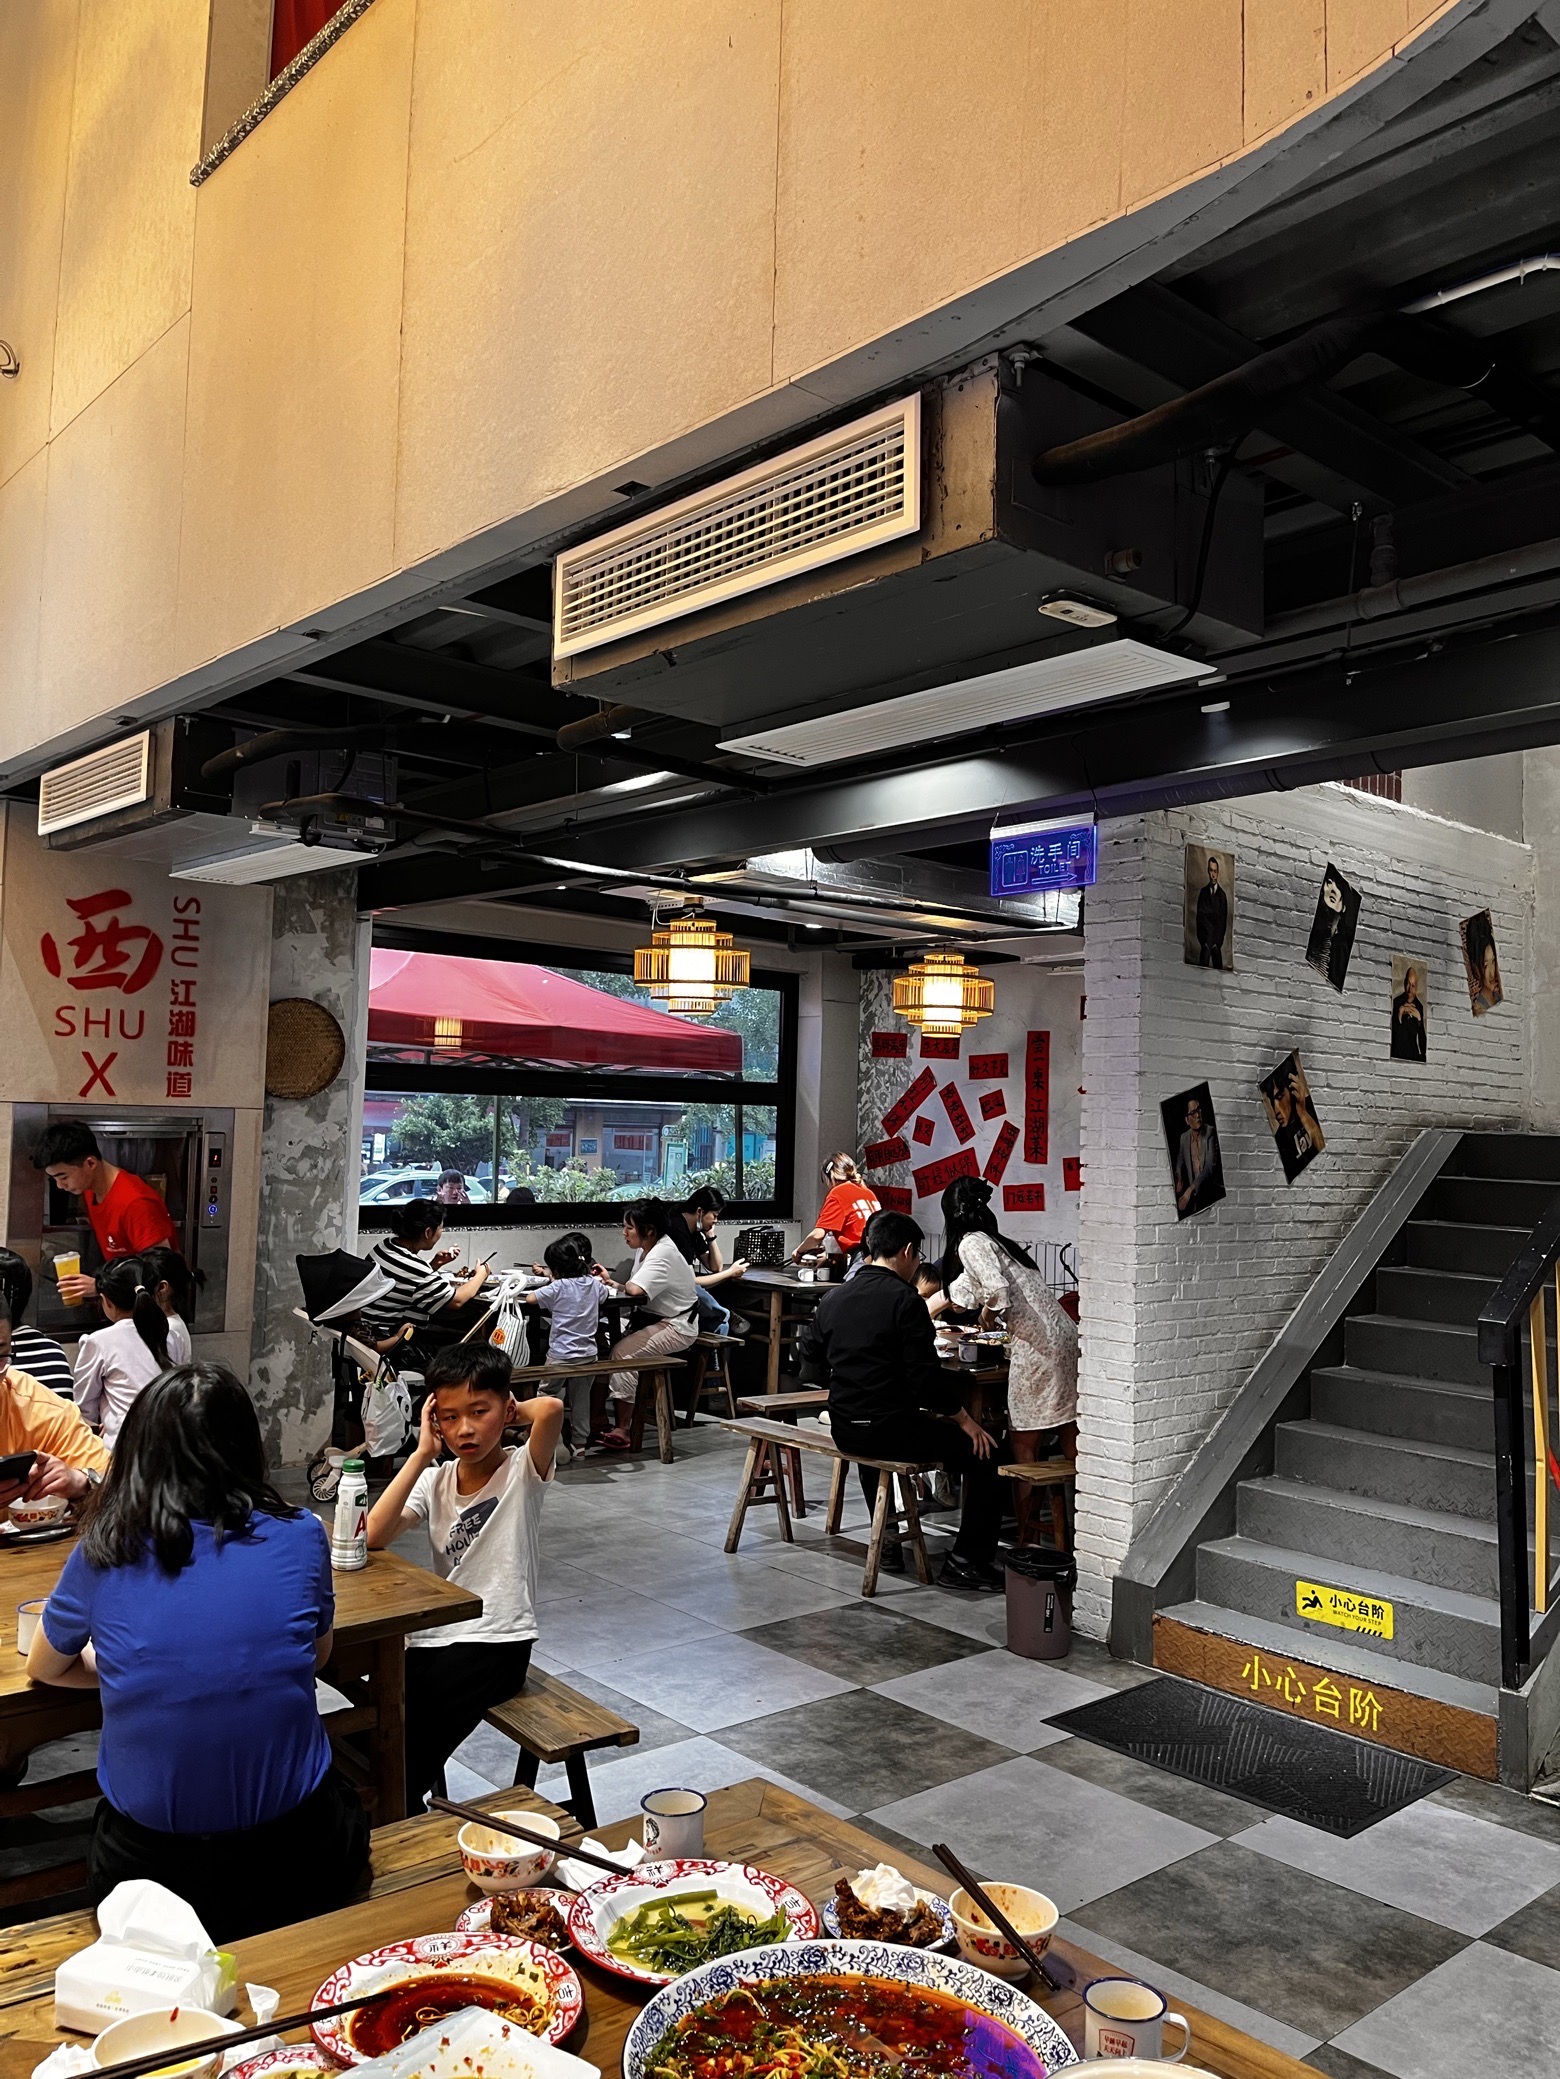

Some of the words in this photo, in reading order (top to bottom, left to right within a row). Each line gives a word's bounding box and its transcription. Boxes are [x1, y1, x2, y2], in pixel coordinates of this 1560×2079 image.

[1031, 841, 1080, 865] 洗手间
[1039, 861, 1071, 875] TOILET
[40, 889, 164, 995] 西
[170, 896, 201, 968] SHU
[54, 1005, 145, 1040] SHU
[166, 979, 197, 1098] 江湖味道
[78, 1051, 118, 1098] X
[1006, 1189, 1042, 1206] 门庭若市
[450, 1513, 481, 1538] FREE
[1329, 1594, 1385, 1620] 小心台阶
[1333, 1610, 1351, 1619] WATCH
[1352, 1614, 1367, 1622] YOUR
[1368, 1618, 1382, 1626] STEP
[1242, 1655, 1384, 1731] 小心台阶
